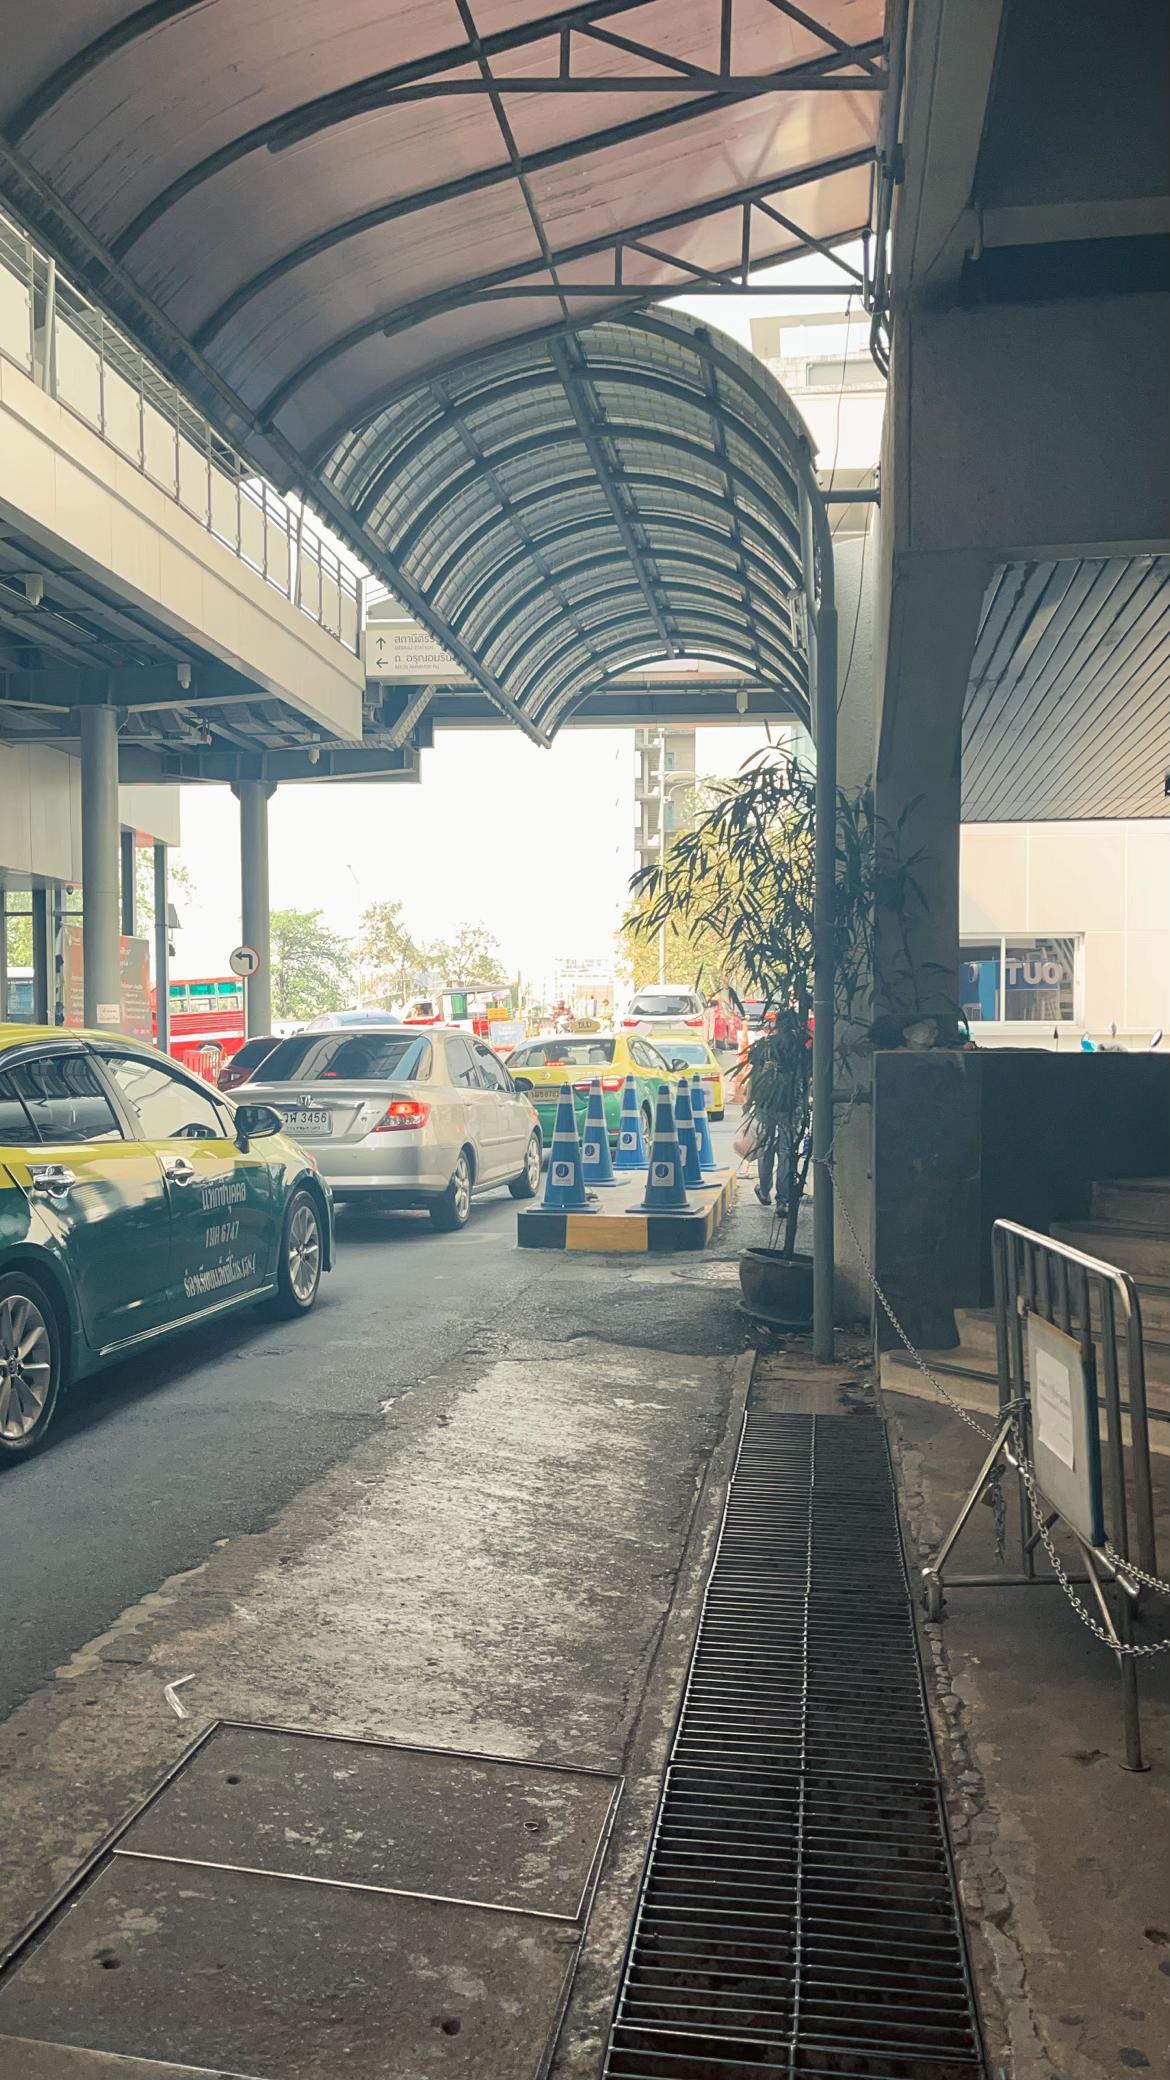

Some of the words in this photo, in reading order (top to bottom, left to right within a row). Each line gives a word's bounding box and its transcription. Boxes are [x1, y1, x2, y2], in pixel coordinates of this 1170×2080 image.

[394, 633, 436, 643] สถานีศิริร
[406, 652, 456, 664] อรุณอมริน
[301, 1112, 327, 1123] 3456
[221, 1220, 240, 1243] 6747
